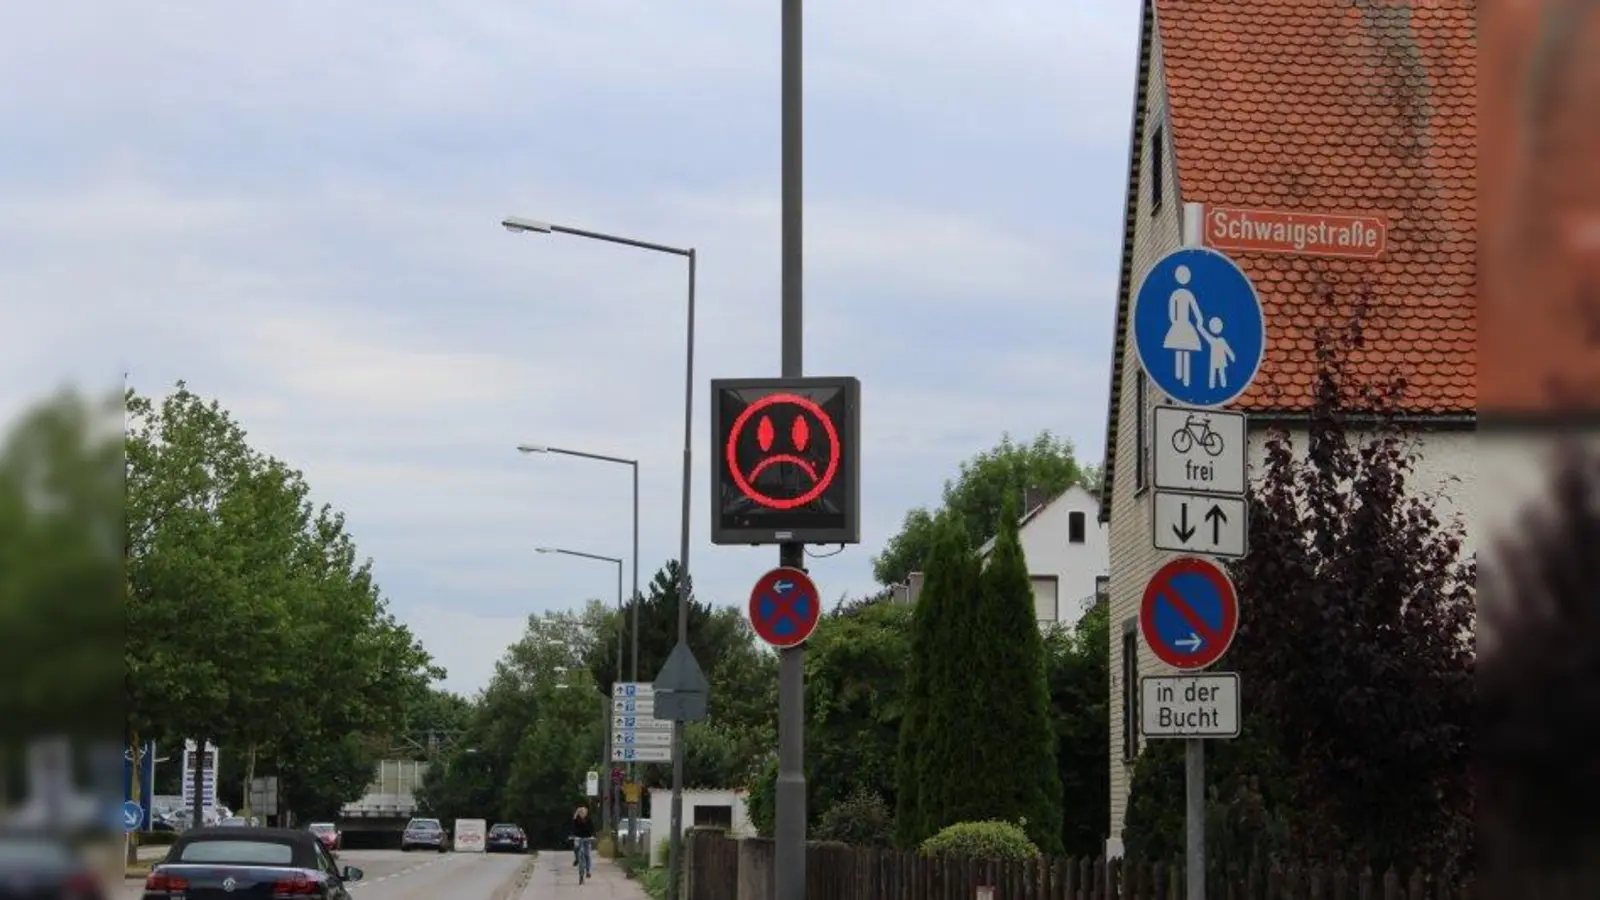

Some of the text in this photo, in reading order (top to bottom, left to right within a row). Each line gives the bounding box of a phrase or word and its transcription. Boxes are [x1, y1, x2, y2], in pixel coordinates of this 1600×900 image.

[1213, 211, 1377, 250] Schwaigstraße
[1186, 459, 1214, 481] frei
[1157, 681, 1220, 702] in der
[1159, 707, 1218, 727] Bucht
